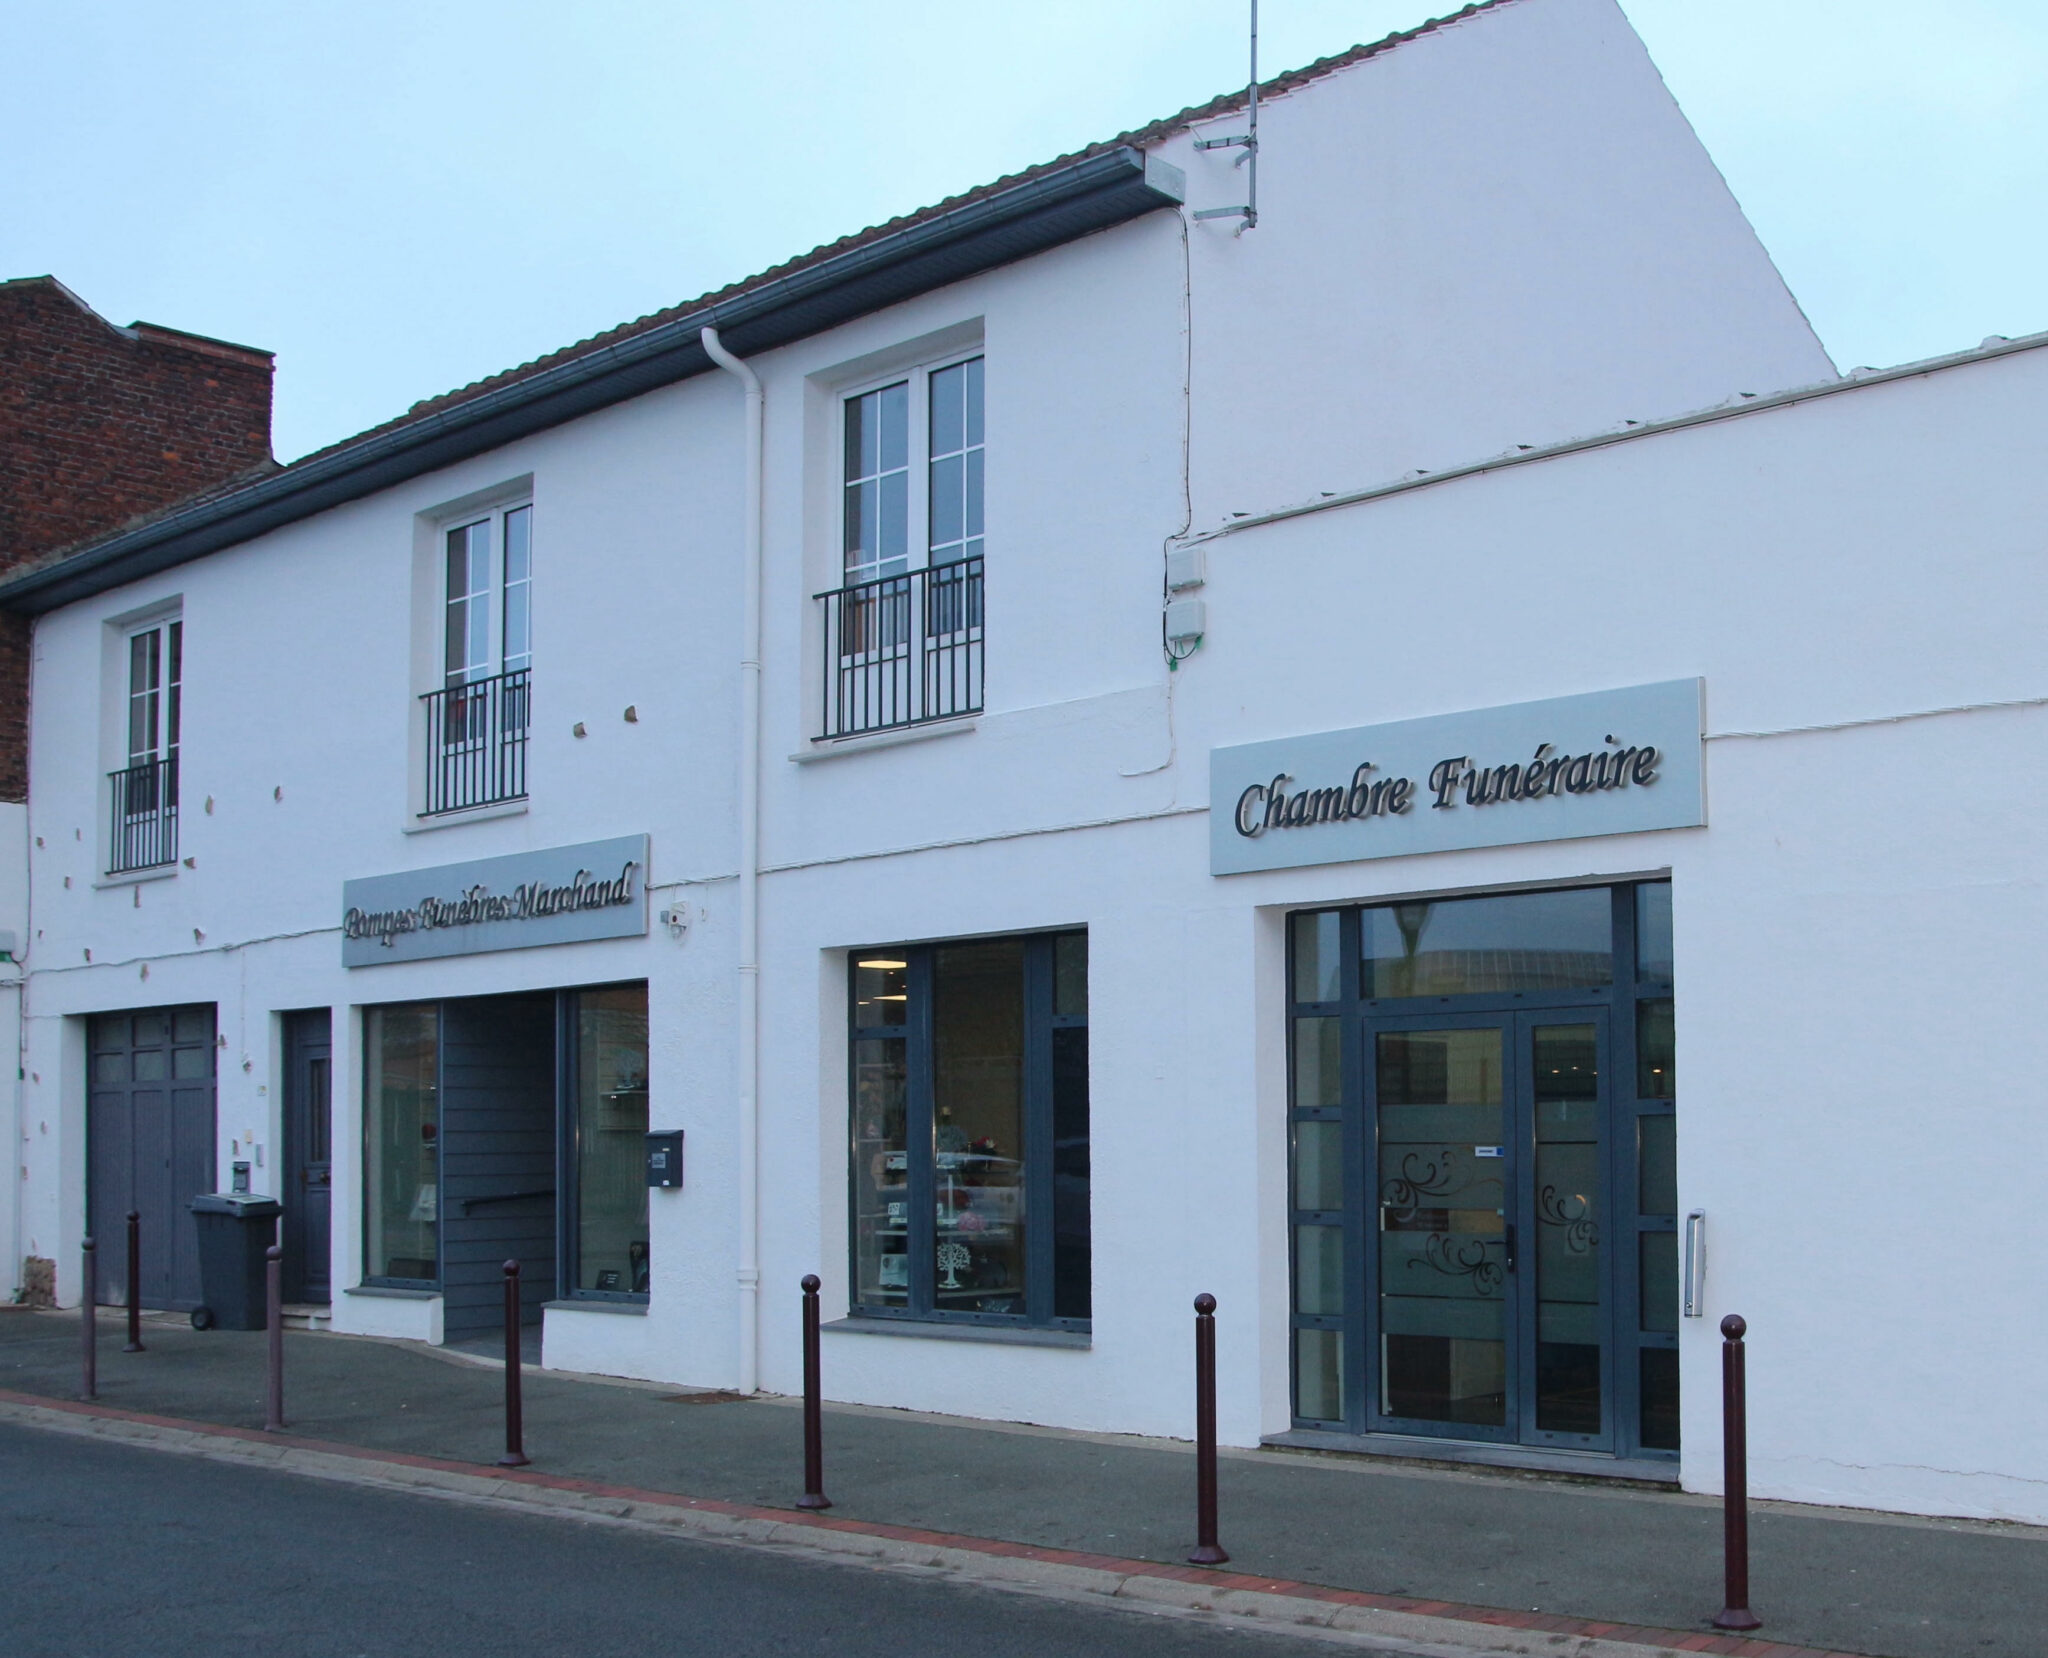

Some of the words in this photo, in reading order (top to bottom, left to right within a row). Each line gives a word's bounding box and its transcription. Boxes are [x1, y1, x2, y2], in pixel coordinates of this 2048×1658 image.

[1234, 761, 1412, 838] Chambre
[1428, 733, 1661, 810] Funéraire
[344, 906, 417, 947] Pompes
[418, 884, 511, 931] Funèbres
[514, 860, 637, 921] Marchand
